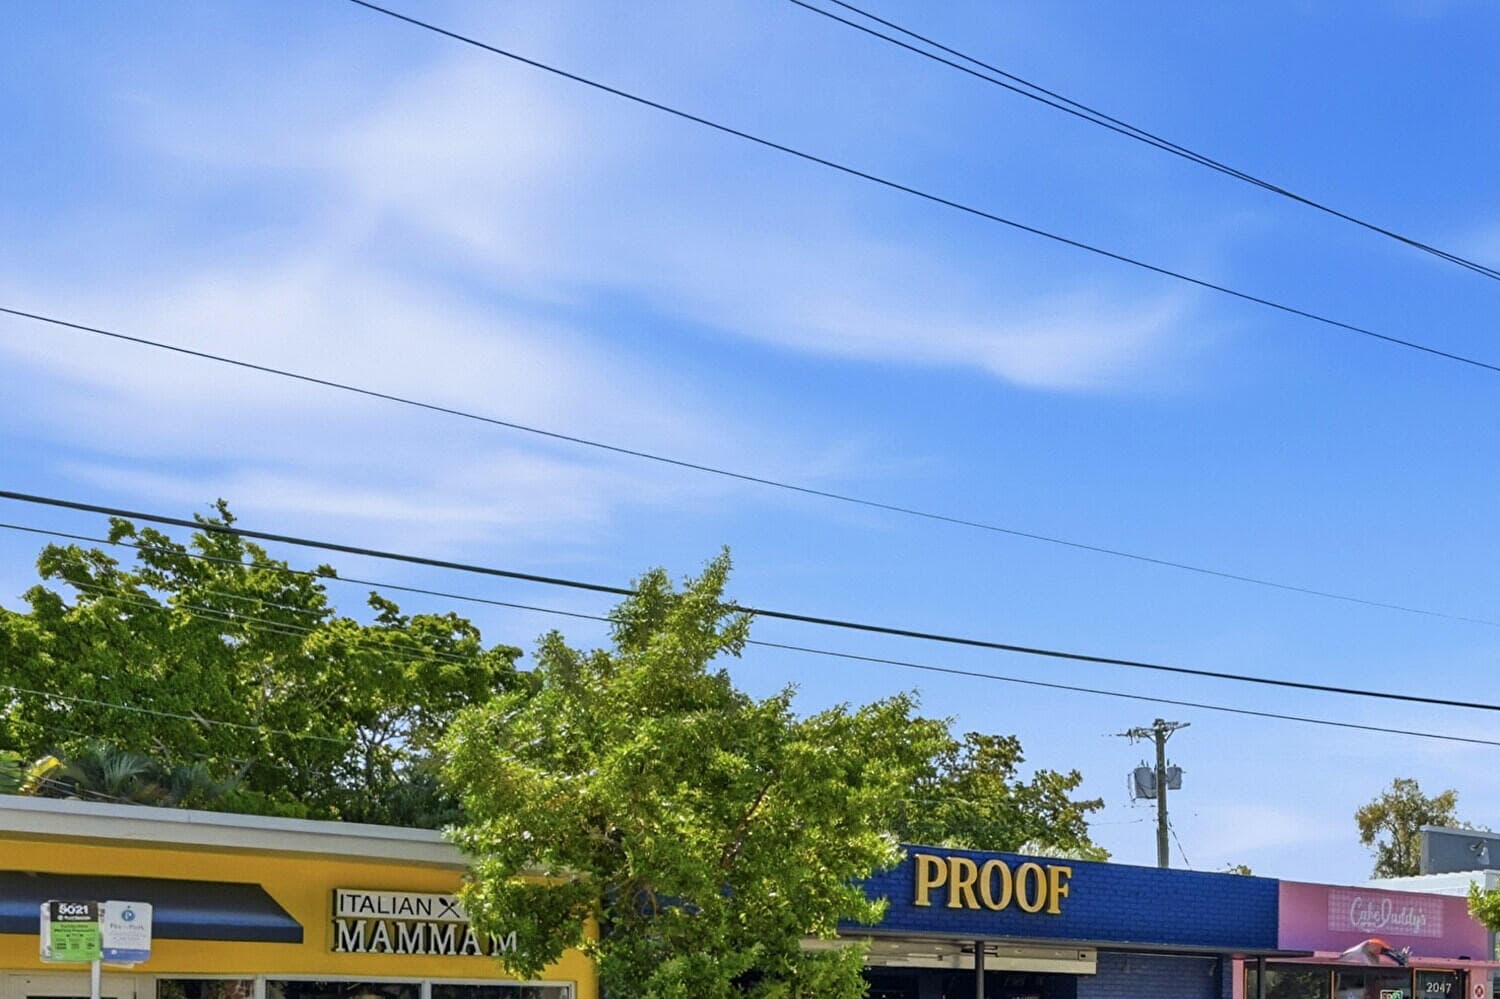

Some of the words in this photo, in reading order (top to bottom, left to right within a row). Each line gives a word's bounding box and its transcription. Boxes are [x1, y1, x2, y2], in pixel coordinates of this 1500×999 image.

[914, 853, 1072, 914] PROOF
[58, 904, 88, 915] 5021
[340, 894, 431, 916] ITALIAN
[335, 918, 482, 956] MAMMA
[1426, 982, 1452, 994] 2047
